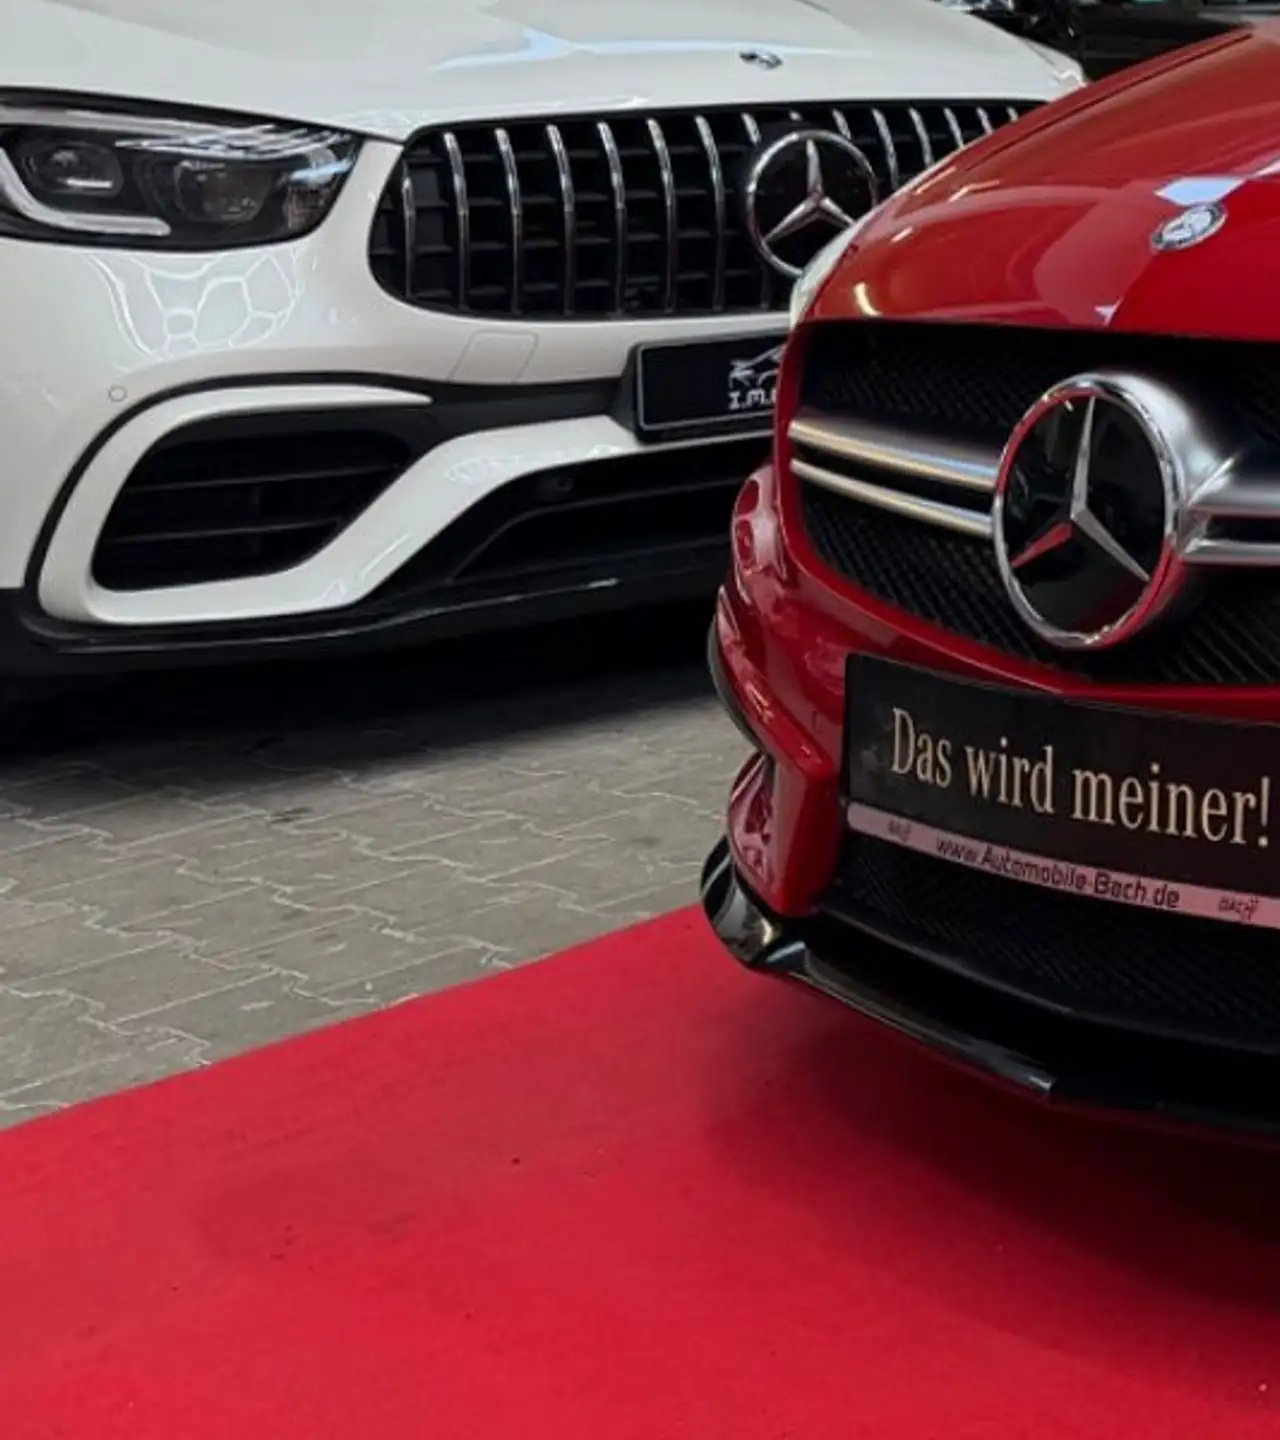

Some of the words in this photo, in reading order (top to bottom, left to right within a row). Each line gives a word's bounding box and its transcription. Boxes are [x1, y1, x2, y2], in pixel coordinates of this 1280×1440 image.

[891, 707, 953, 789] Das
[964, 736, 1055, 815] wird
[1071, 762, 1271, 849] meiner!
